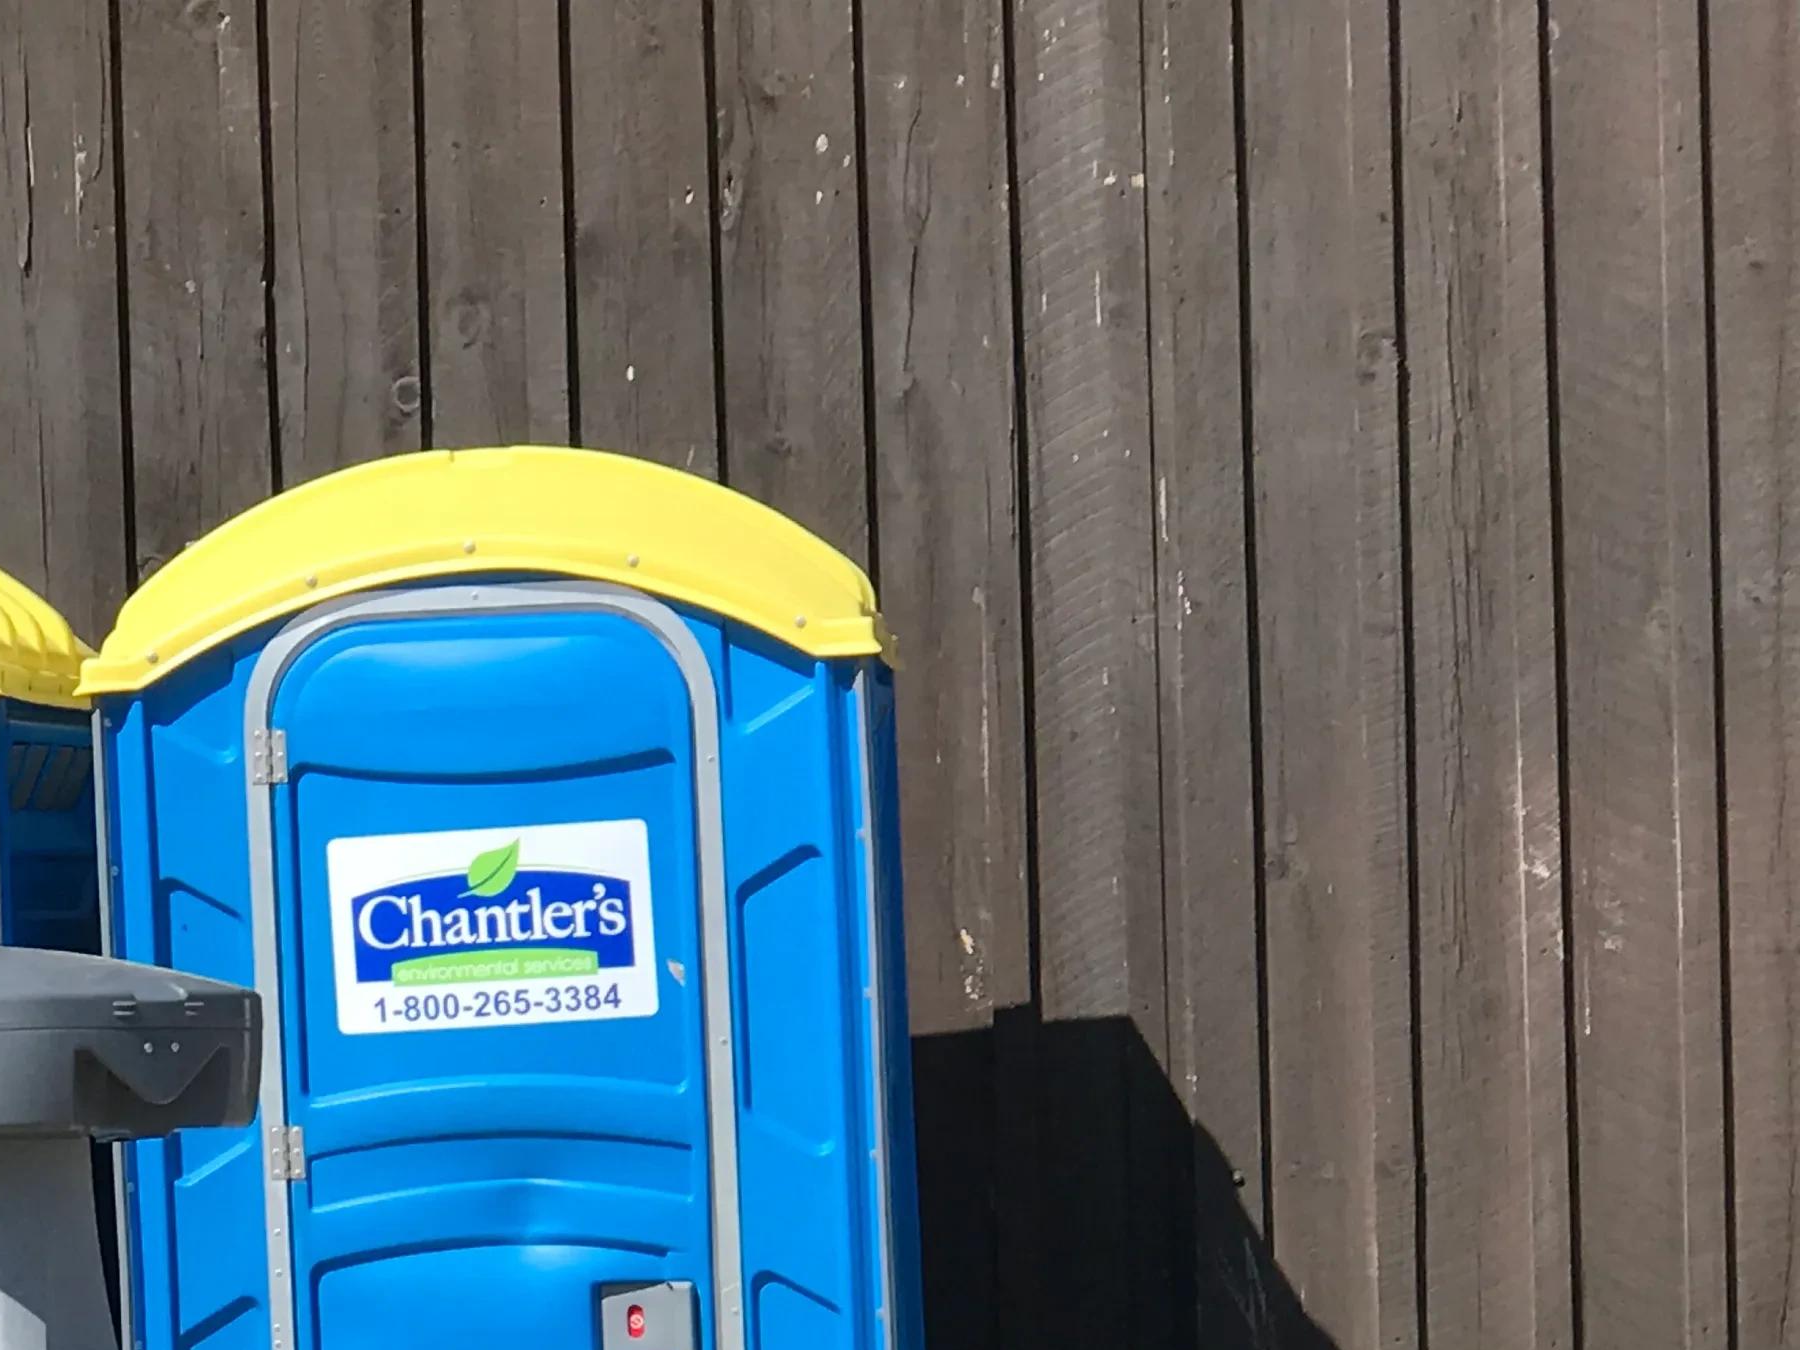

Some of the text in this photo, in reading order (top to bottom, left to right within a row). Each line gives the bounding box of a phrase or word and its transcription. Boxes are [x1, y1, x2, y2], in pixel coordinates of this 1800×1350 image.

[357, 882, 628, 951] Chantler's
[396, 956, 593, 982] environmental services
[373, 982, 622, 1023] 1-800-265-3384
